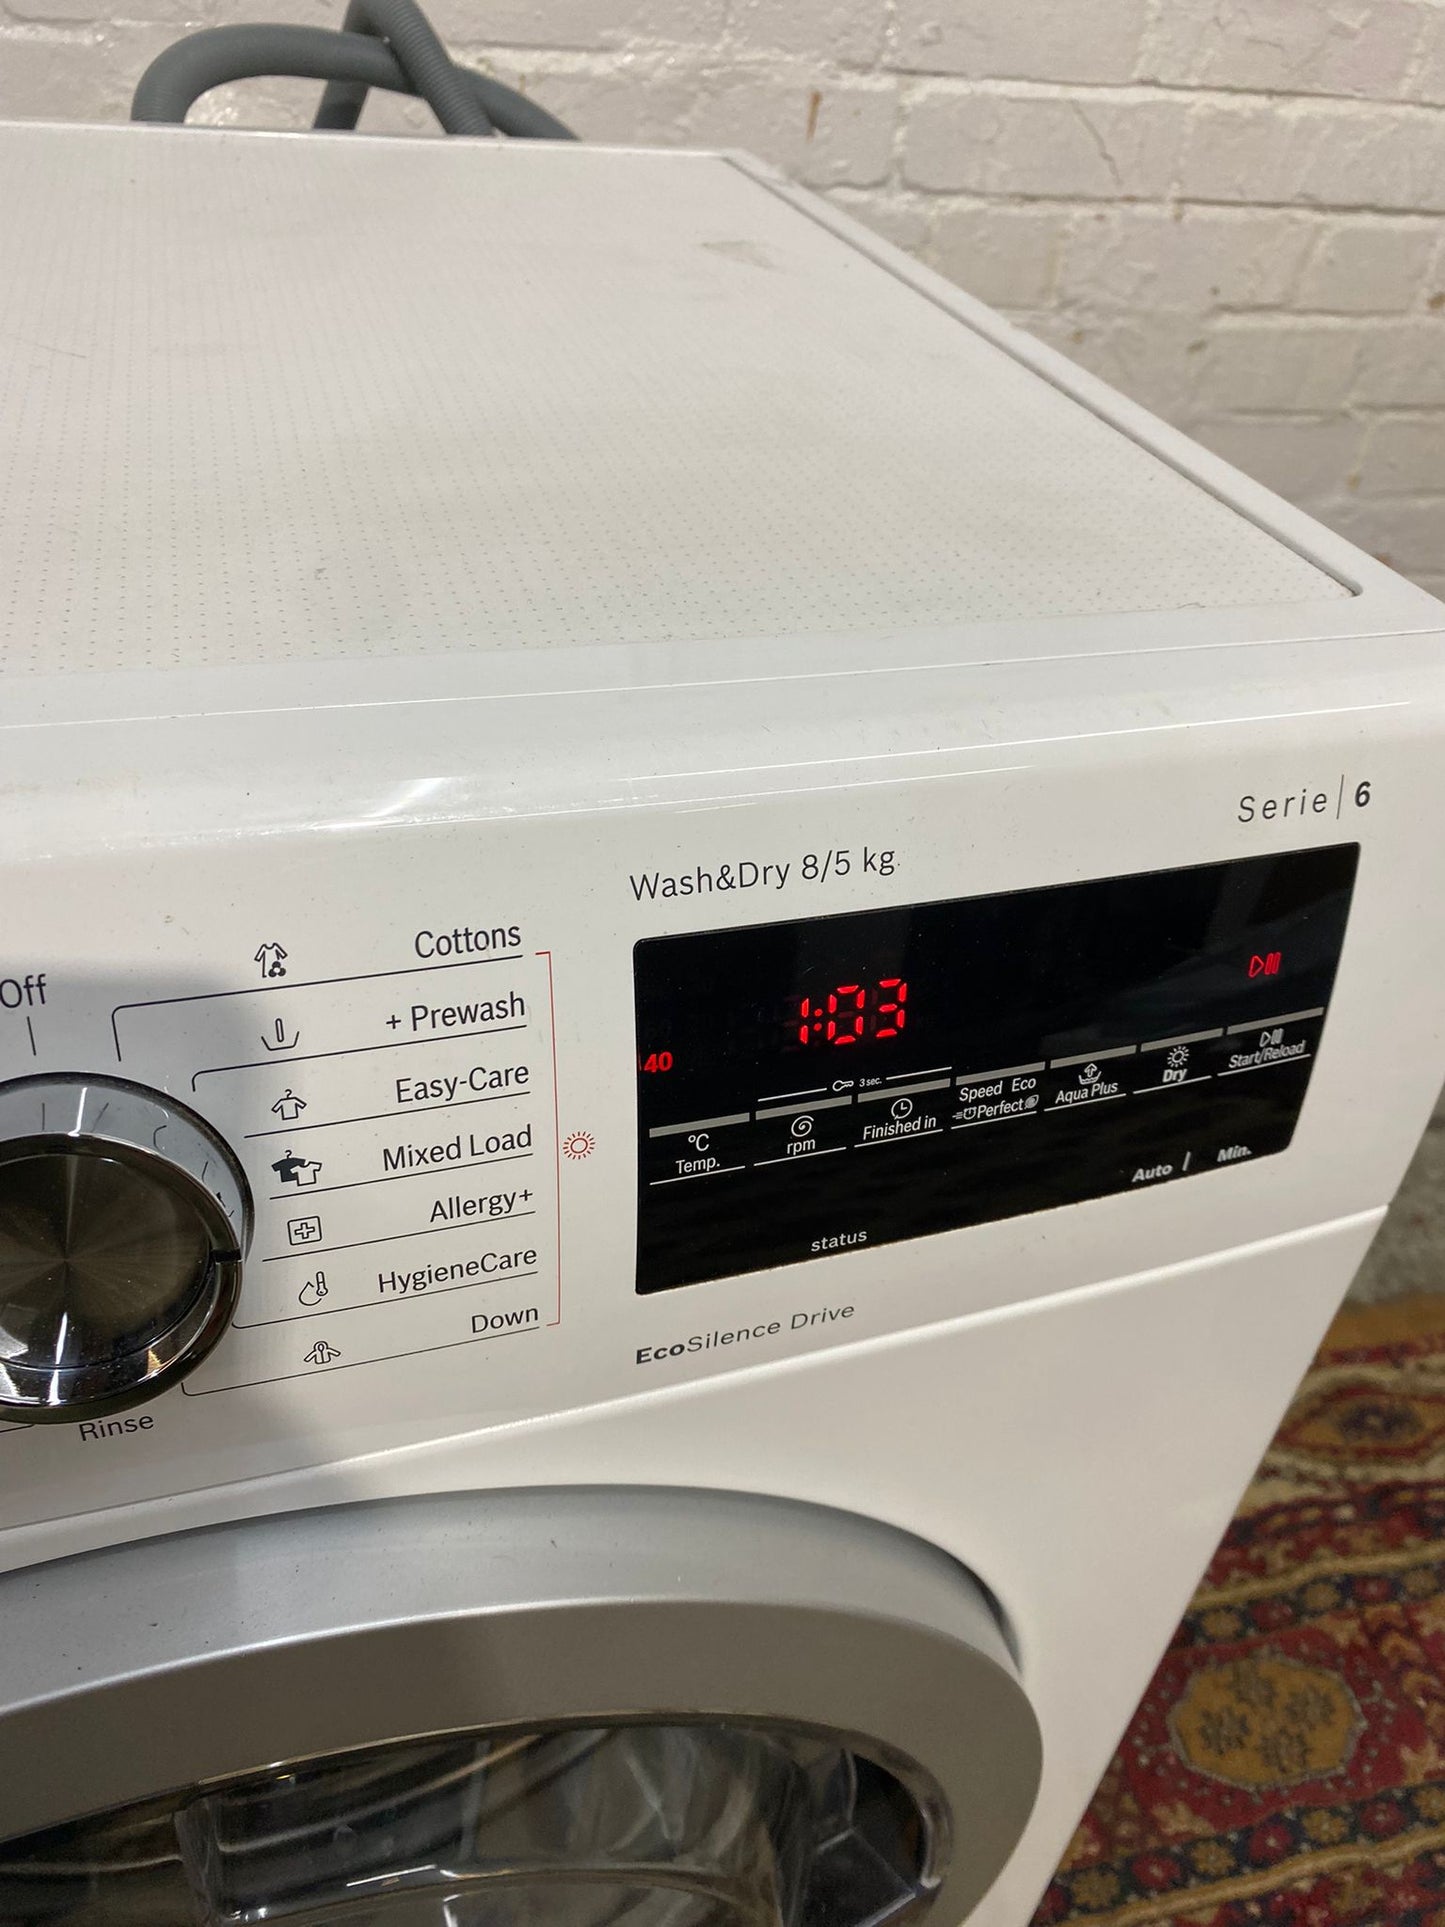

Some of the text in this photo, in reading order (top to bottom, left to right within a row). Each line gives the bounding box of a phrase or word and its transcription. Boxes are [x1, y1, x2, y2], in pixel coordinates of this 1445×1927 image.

[1238, 782, 1371, 823] Serie 6
[630, 847, 896, 902] Wash&Dry 8/5 kg
[414, 925, 521, 960] Cottons
[0, 974, 46, 1009] Off
[411, 992, 525, 1032] Prewash
[800, 978, 907, 1046] 1:03
[644, 1052, 672, 1072] 40
[1228, 1040, 1305, 1069] Start/Reload
[396, 1064, 529, 1105] Easy-Care
[859, 1077, 882, 1087] 3 sec.
[959, 1077, 1036, 1102] Speed Eco
[1162, 1067, 1187, 1084] Dry
[1055, 1081, 1118, 1104] Aqua Plus
[977, 1098, 1024, 1119] Perfect
[863, 1115, 936, 1140] Finished in
[383, 1125, 532, 1172] Mixed Load
[688, 1134, 709, 1151] °C
[787, 1138, 815, 1155] rpm
[676, 1157, 720, 1174] Temp.
[1131, 1144, 1252, 1183] Auto Min.
[430, 1188, 534, 1223] Allergy+
[811, 1230, 867, 1251] status
[378, 1248, 537, 1294] HygieneCare
[471, 1307, 538, 1334] Down
[635, 1303, 855, 1365] EcoSilence Drive
[80, 1413, 154, 1441] Rinse
